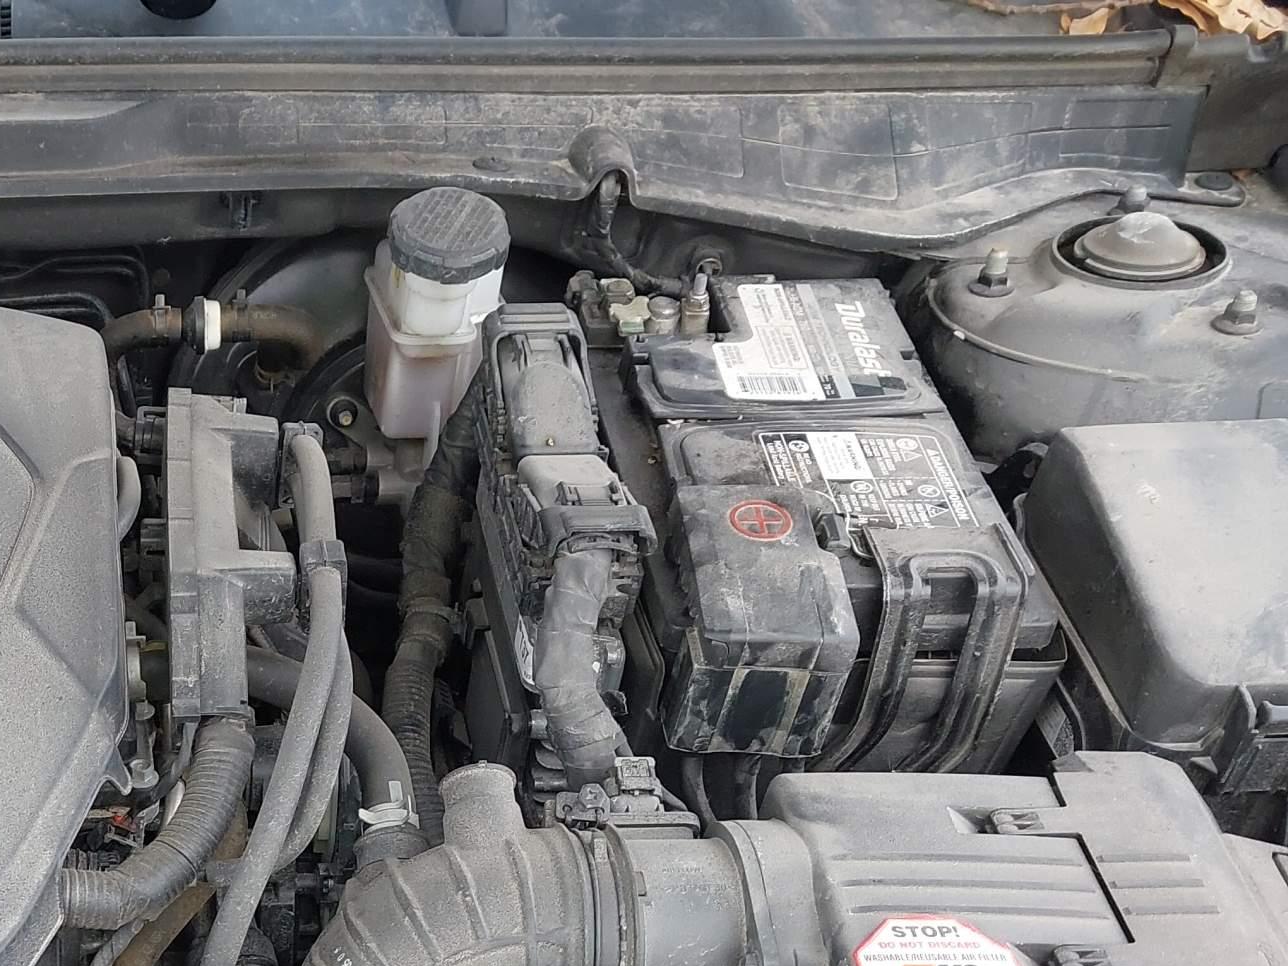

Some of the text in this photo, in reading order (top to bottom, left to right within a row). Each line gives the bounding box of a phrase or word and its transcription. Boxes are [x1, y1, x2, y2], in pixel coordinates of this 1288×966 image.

[835, 301, 892, 379] Duralast
[772, 440, 796, 481] NON-SPILLABLE
[929, 456, 969, 520] DANGER/POISON
[892, 926, 960, 938] STOP!
[864, 952, 1007, 962] WASHABLE/REUSABLE AIR FILTER
